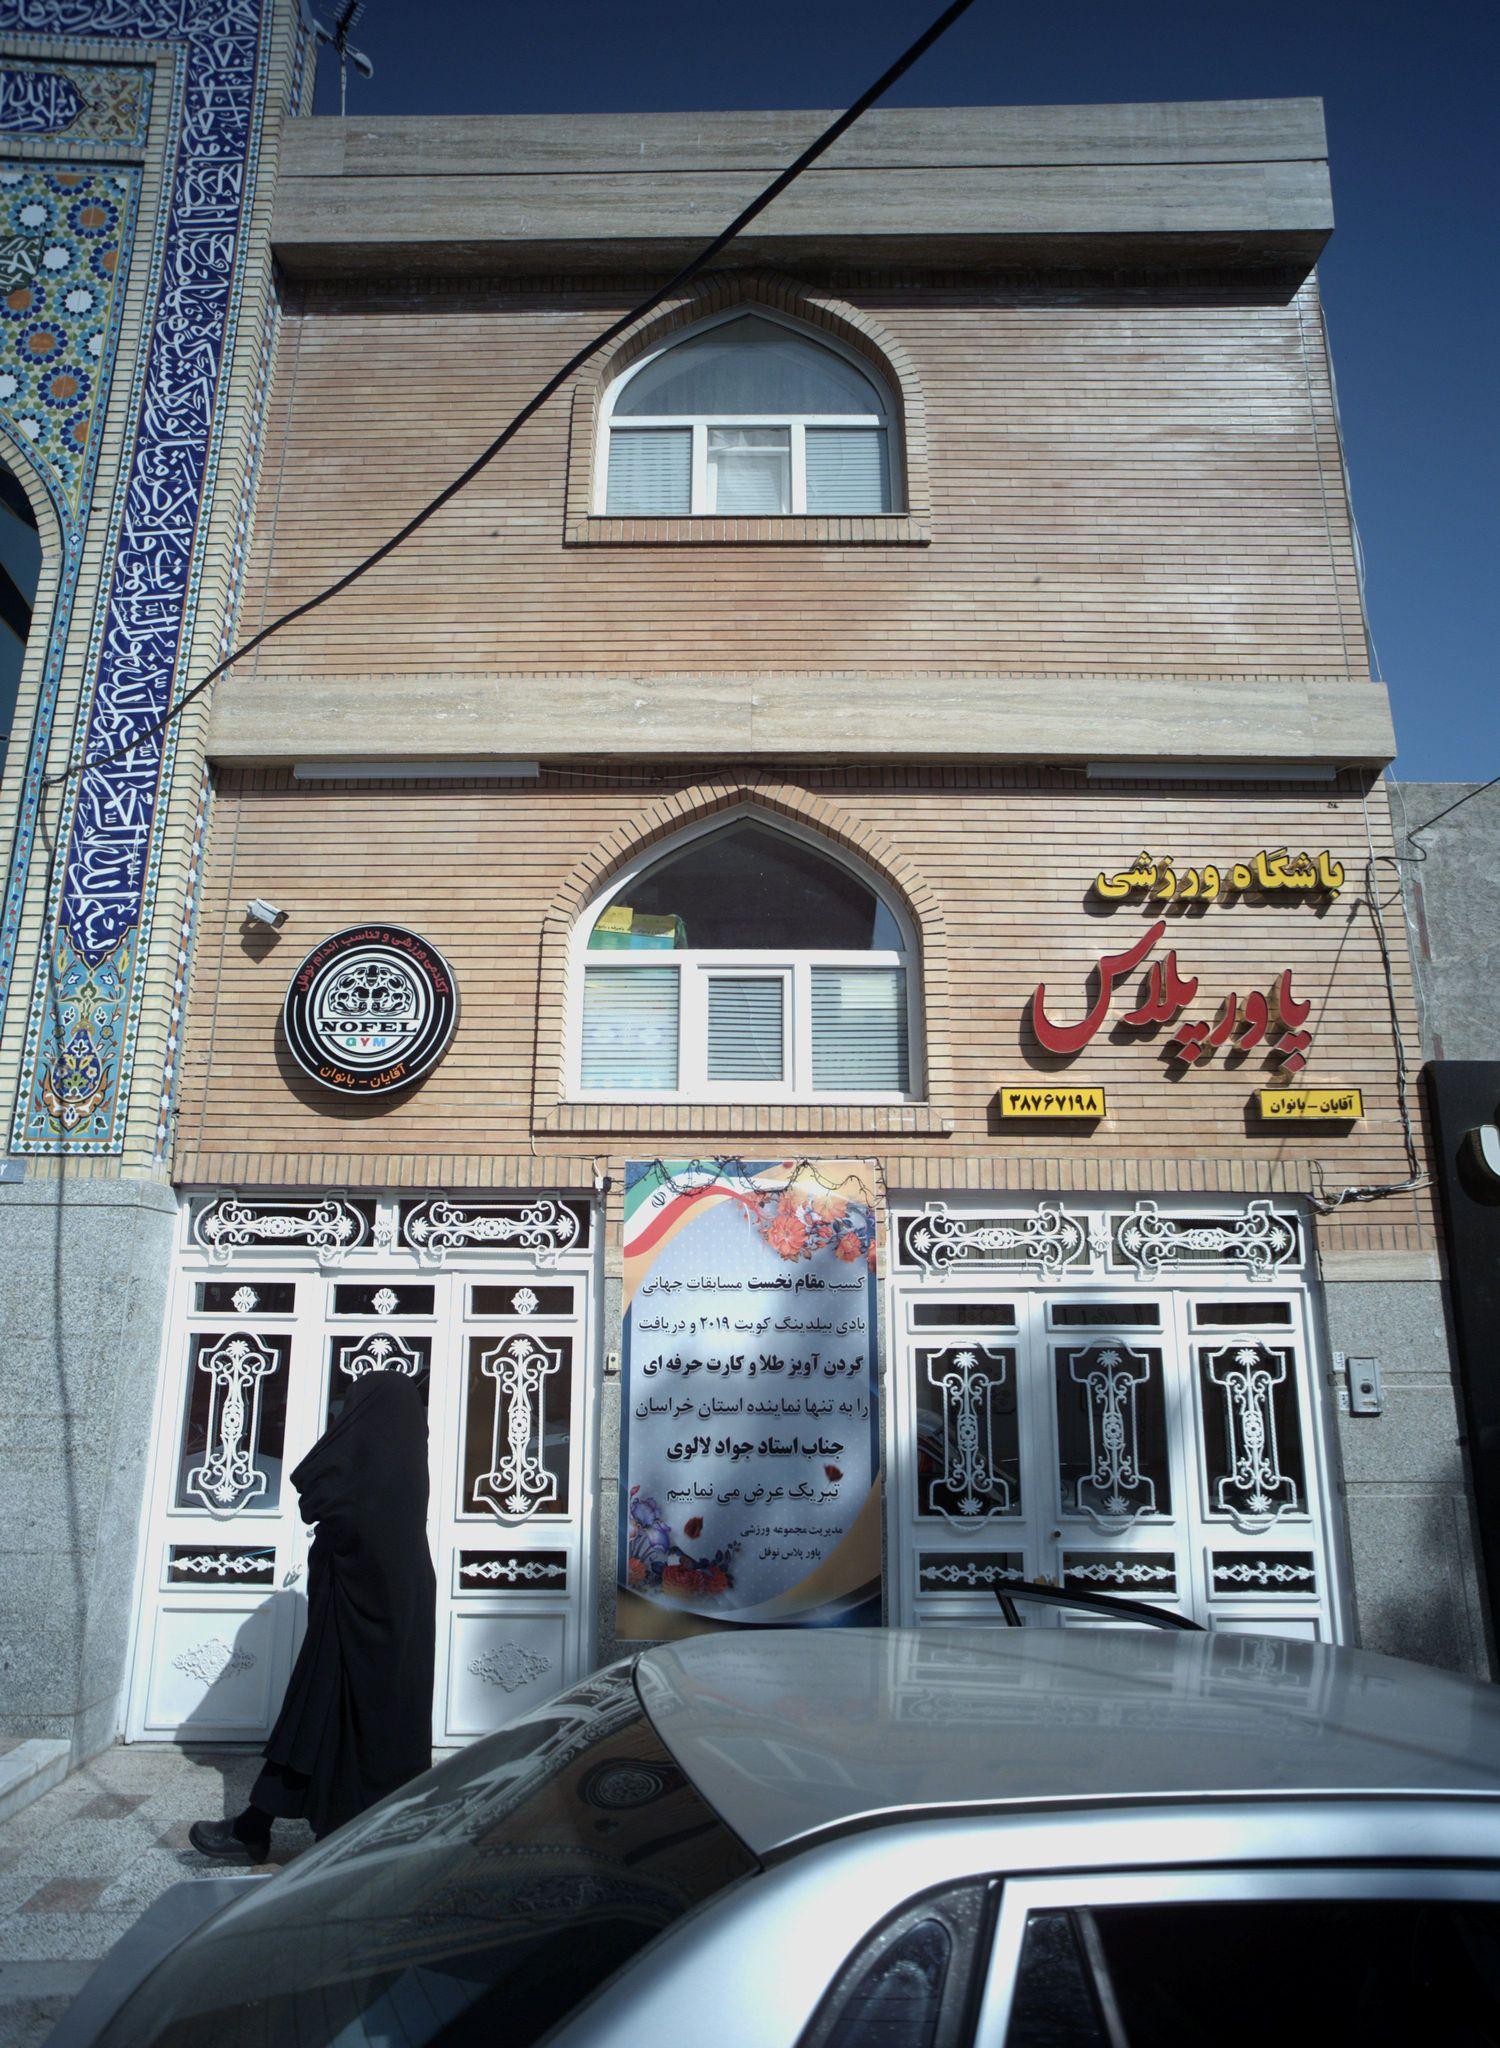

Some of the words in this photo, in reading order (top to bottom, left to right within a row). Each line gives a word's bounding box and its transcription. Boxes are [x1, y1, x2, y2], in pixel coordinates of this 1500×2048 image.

[1096, 849, 1221, 898] ورزشی
[1231, 845, 1345, 899] باشگاه
[319, 1020, 418, 1034] NOFEL
[1209, 968, 1313, 1074] پاور
[345, 1036, 387, 1048] GYM
[319, 1064, 357, 1088] بانوان
[370, 1062, 408, 1088] آقایان
[1009, 1093, 1098, 1113] ۳۸۷۶۷۱۹۸
[1269, 1097, 1306, 1115] بانوان
[1319, 1093, 1355, 1115] آقایان
[641, 1275, 684, 1296] جهانی
[686, 1275, 743, 1293] مسابقات
[747, 1273, 793, 1295] نخست
[794, 1273, 826, 1295] مقام
[828, 1276, 866, 1291] کسب
[638, 1317, 686, 1334] دریافت
[689, 1321, 697, 1335] و
[699, 1315, 730, 1331] ۲۰۱۹
[733, 1316, 771, 1335] کویت
[774, 1315, 833, 1335] بیلدینگ
[835, 1316, 867, 1338] بادی
[642, 1354, 664, 1377] ای
[664, 1355, 703, 1377] حرفه
[706, 1354, 745, 1377] کارت
[748, 1360, 757, 1377] و
[759, 1354, 785, 1371] طلا
[788, 1352, 821, 1377] آویز
[822, 1354, 865, 1377] گردن
[635, 1397, 695, 1418] خراسان
[698, 1397, 744, 1418] استان
[746, 1397, 801, 1418] نماینده
[803, 1397, 833, 1418] تنها
[837, 1400, 855, 1416] به
[856, 1398, 869, 1419] را
[714, 1436, 755, 1462] جواد
[757, 1436, 799, 1455] استاد
[801, 1436, 845, 1461] جناب
[666, 1481, 714, 1502] نماییم
[716, 1487, 740, 1503] می
[743, 1486, 785, 1503] عرض
[788, 1480, 840, 1503] تبریک
[739, 1524, 771, 1539] ورزشی
[772, 1525, 807, 1537] مجموعه
[808, 1525, 844, 1538] مدیریت
[784, 1547, 804, 1562] پلاس
[805, 1547, 823, 1561] پاور
